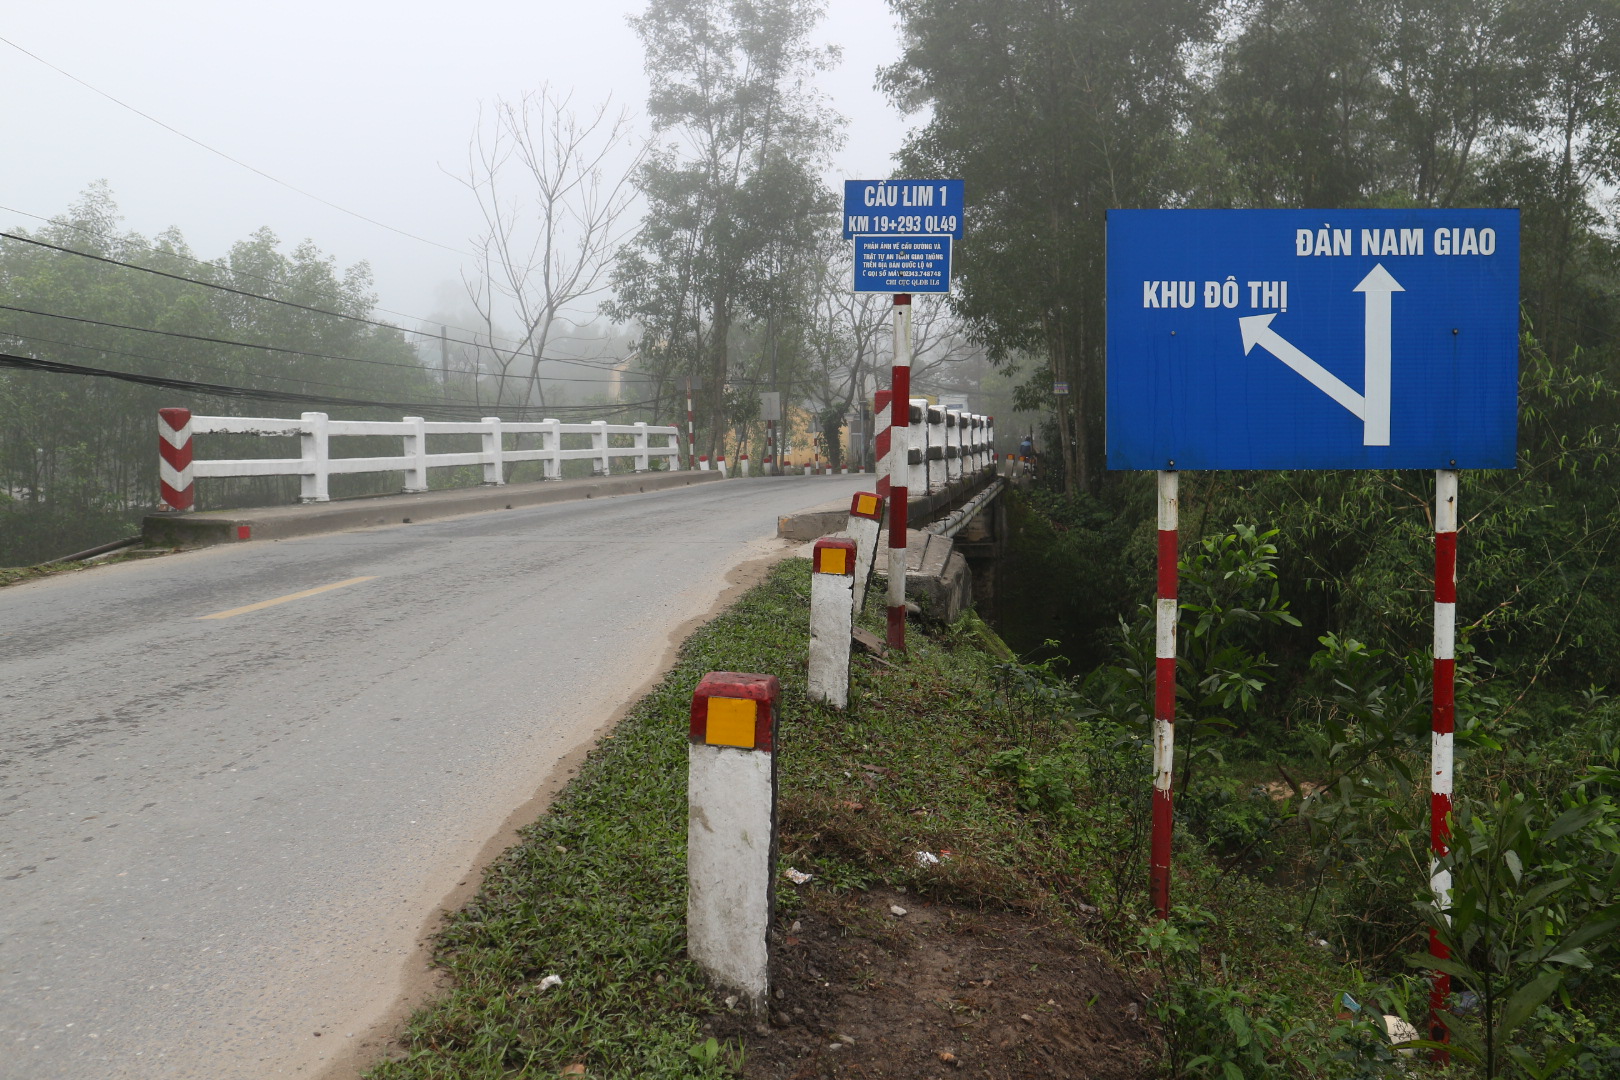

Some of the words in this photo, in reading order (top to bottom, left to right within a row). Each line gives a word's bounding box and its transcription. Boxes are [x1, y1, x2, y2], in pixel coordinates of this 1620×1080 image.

[864, 180, 898, 207] CẦU
[902, 185, 933, 207] LIM
[939, 185, 947, 207] 1
[848, 215, 869, 232] KM
[873, 215, 921, 232] 19+293
[925, 215, 957, 233] QL49
[1295, 223, 1352, 257] ĐÀN
[1361, 228, 1424, 256] NAM
[1433, 227, 1496, 256] GIAO
[1143, 280, 1196, 309] KHU
[1203, 275, 1239, 309] ĐÔ
[1247, 280, 1288, 313] THỊ
